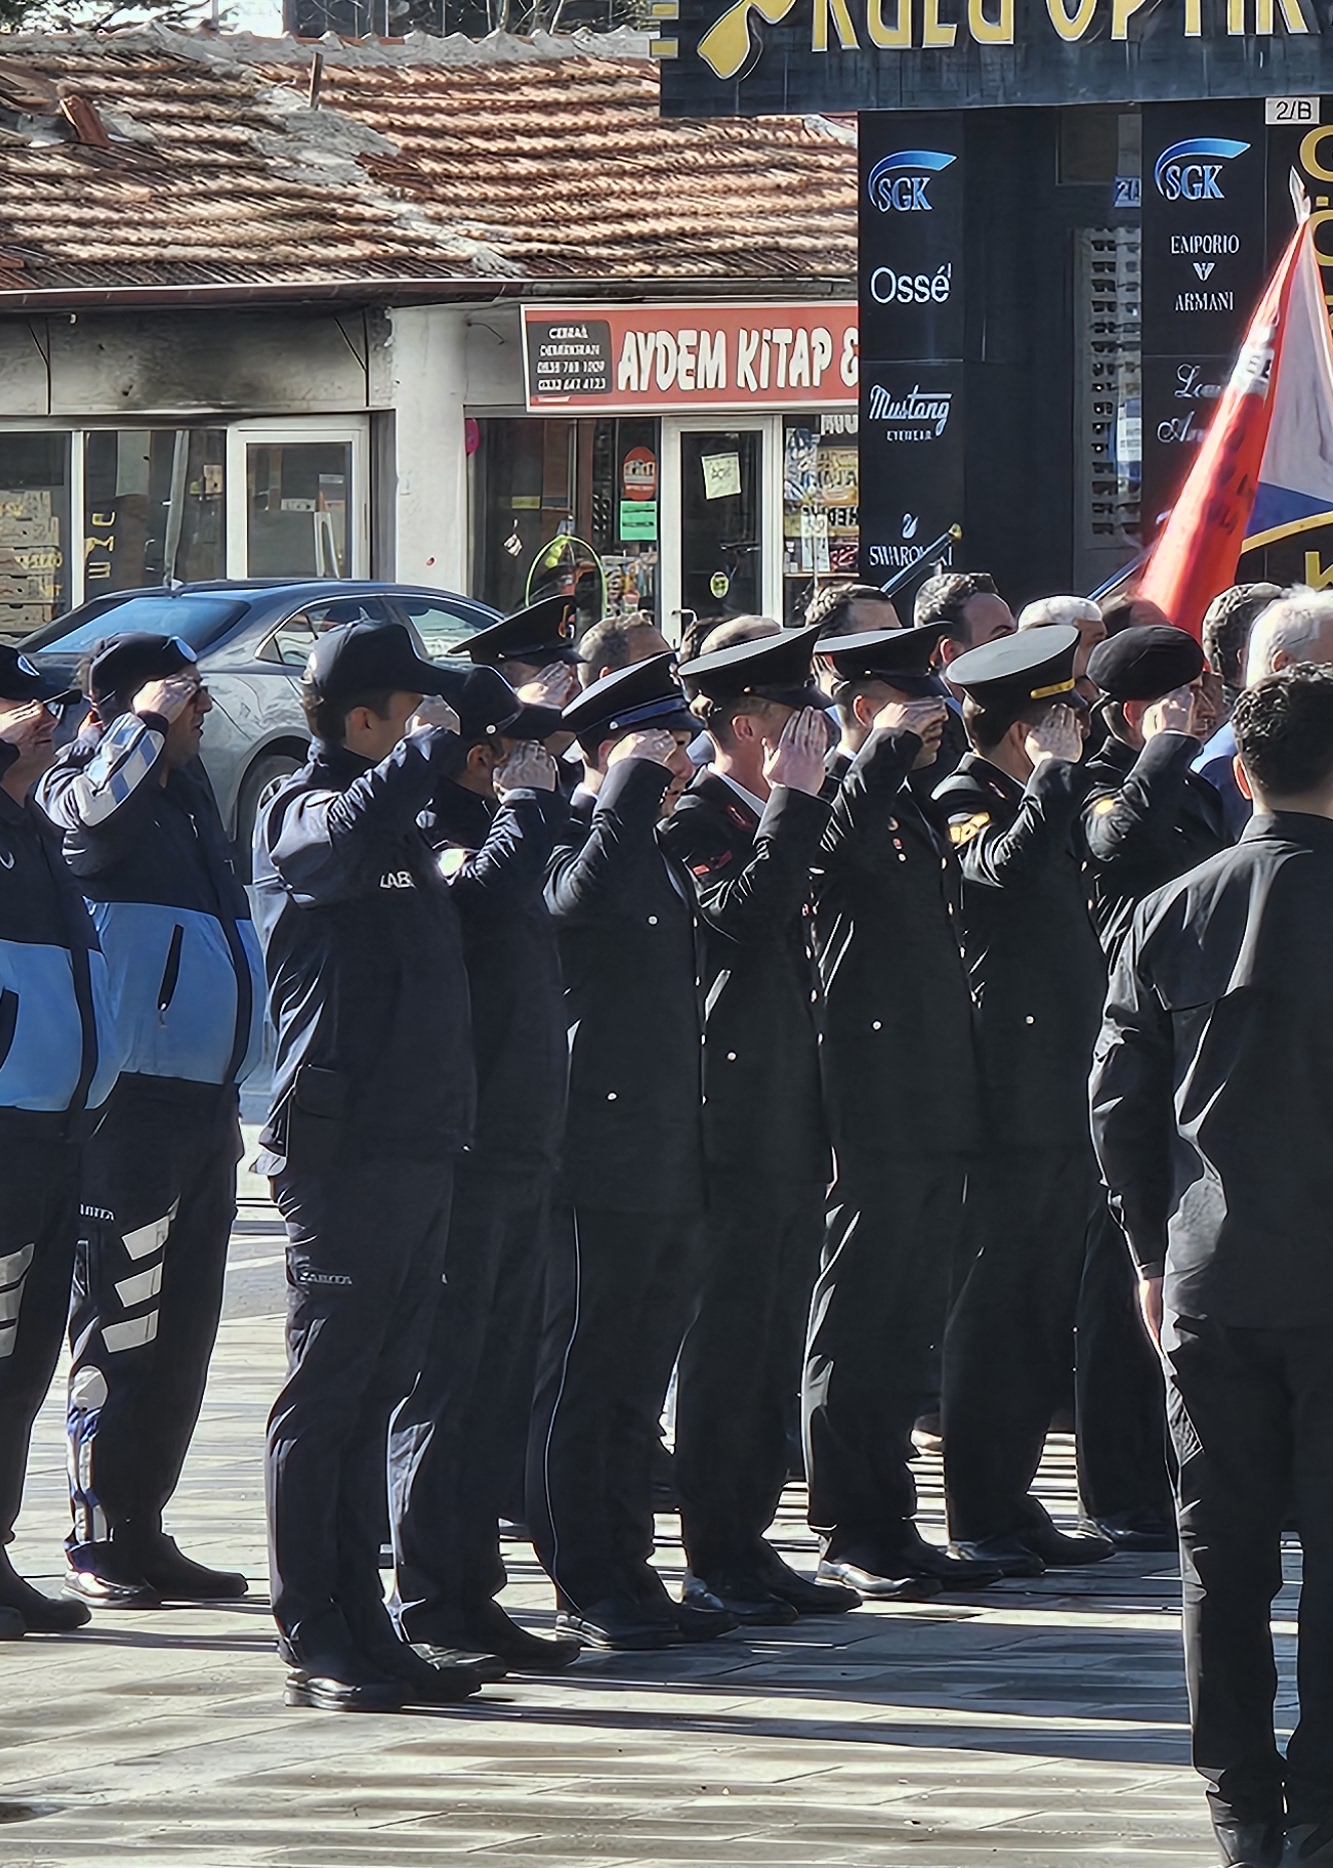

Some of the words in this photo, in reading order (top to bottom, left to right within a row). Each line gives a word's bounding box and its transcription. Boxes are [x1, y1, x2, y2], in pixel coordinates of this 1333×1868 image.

[1276, 100, 1313, 121] 2/B
[877, 176, 933, 213] SGK
[1166, 164, 1225, 201] SGK
[1170, 233, 1241, 255] EMPORIO
[1174, 291, 1235, 312] ARMANI
[616, 329, 727, 392] AYDEM
[869, 384, 953, 437] Mustang
[869, 545, 953, 567] SWAROI
